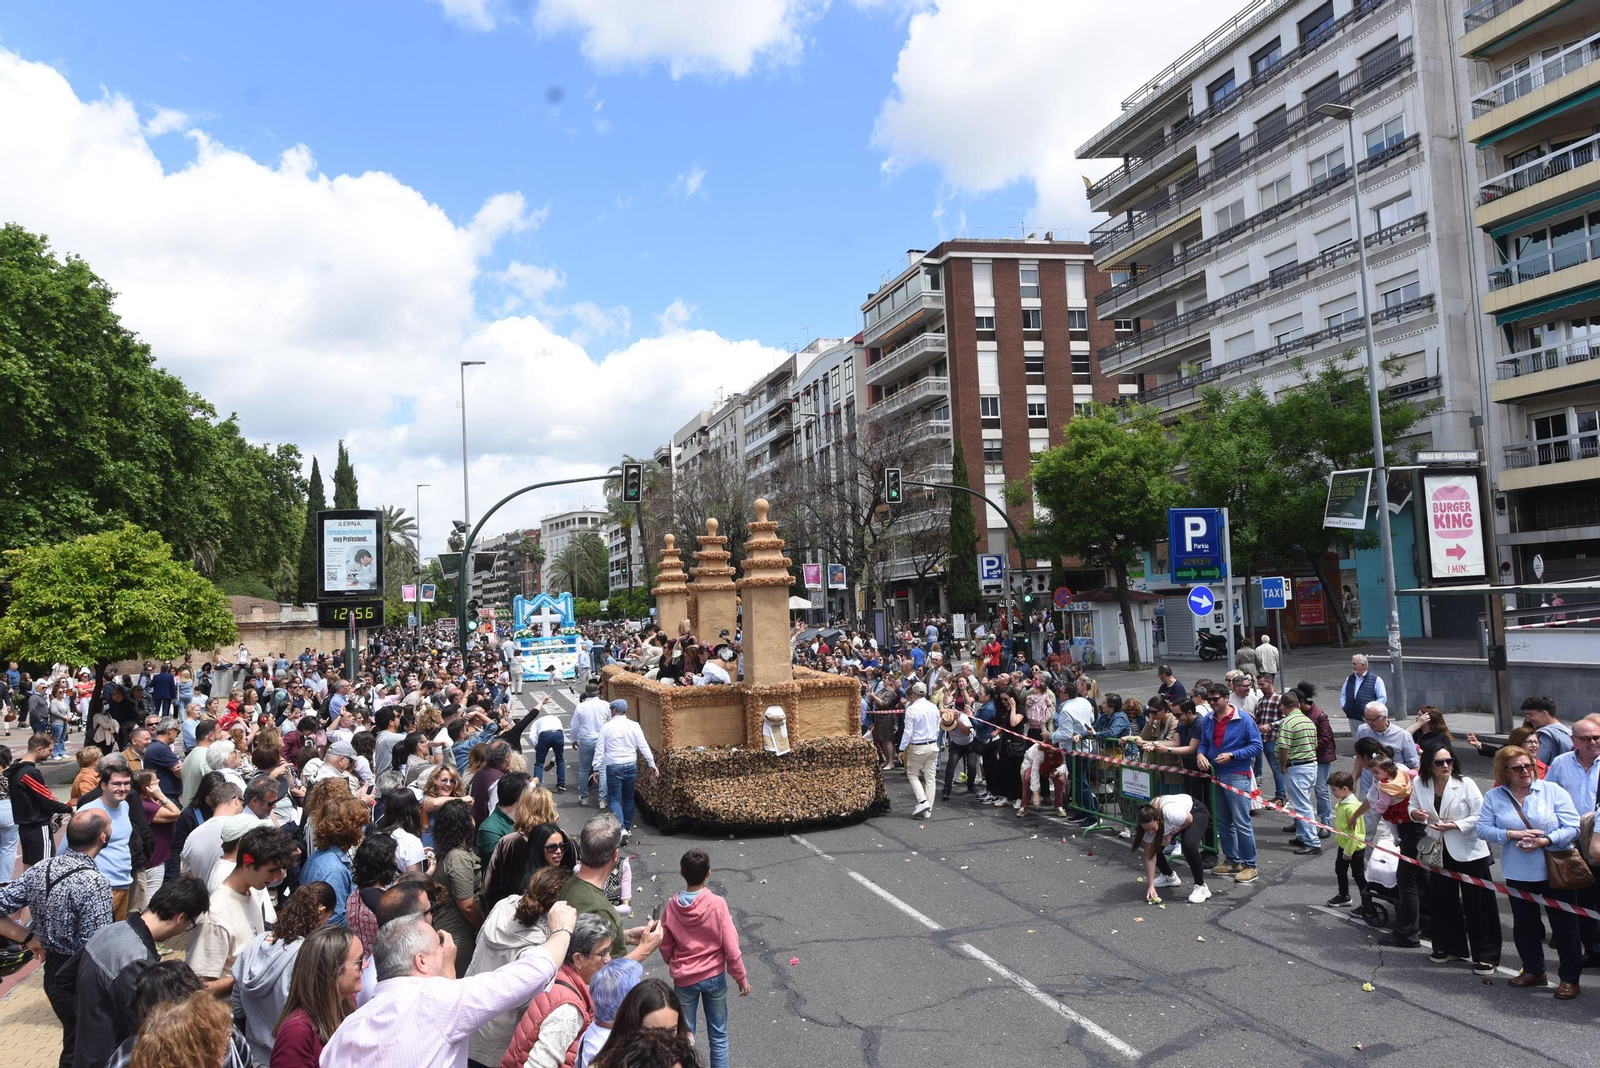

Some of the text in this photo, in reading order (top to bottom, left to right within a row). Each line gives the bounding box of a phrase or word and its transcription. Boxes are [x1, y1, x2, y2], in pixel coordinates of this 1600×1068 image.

[1432, 501, 1472, 513] BURGER
[1434, 514, 1474, 529] KING
[1184, 516, 1206, 552] P
[982, 557, 1000, 577] P
[1447, 566, 1450, 574] 1
[1263, 588, 1283, 599] TAXI
